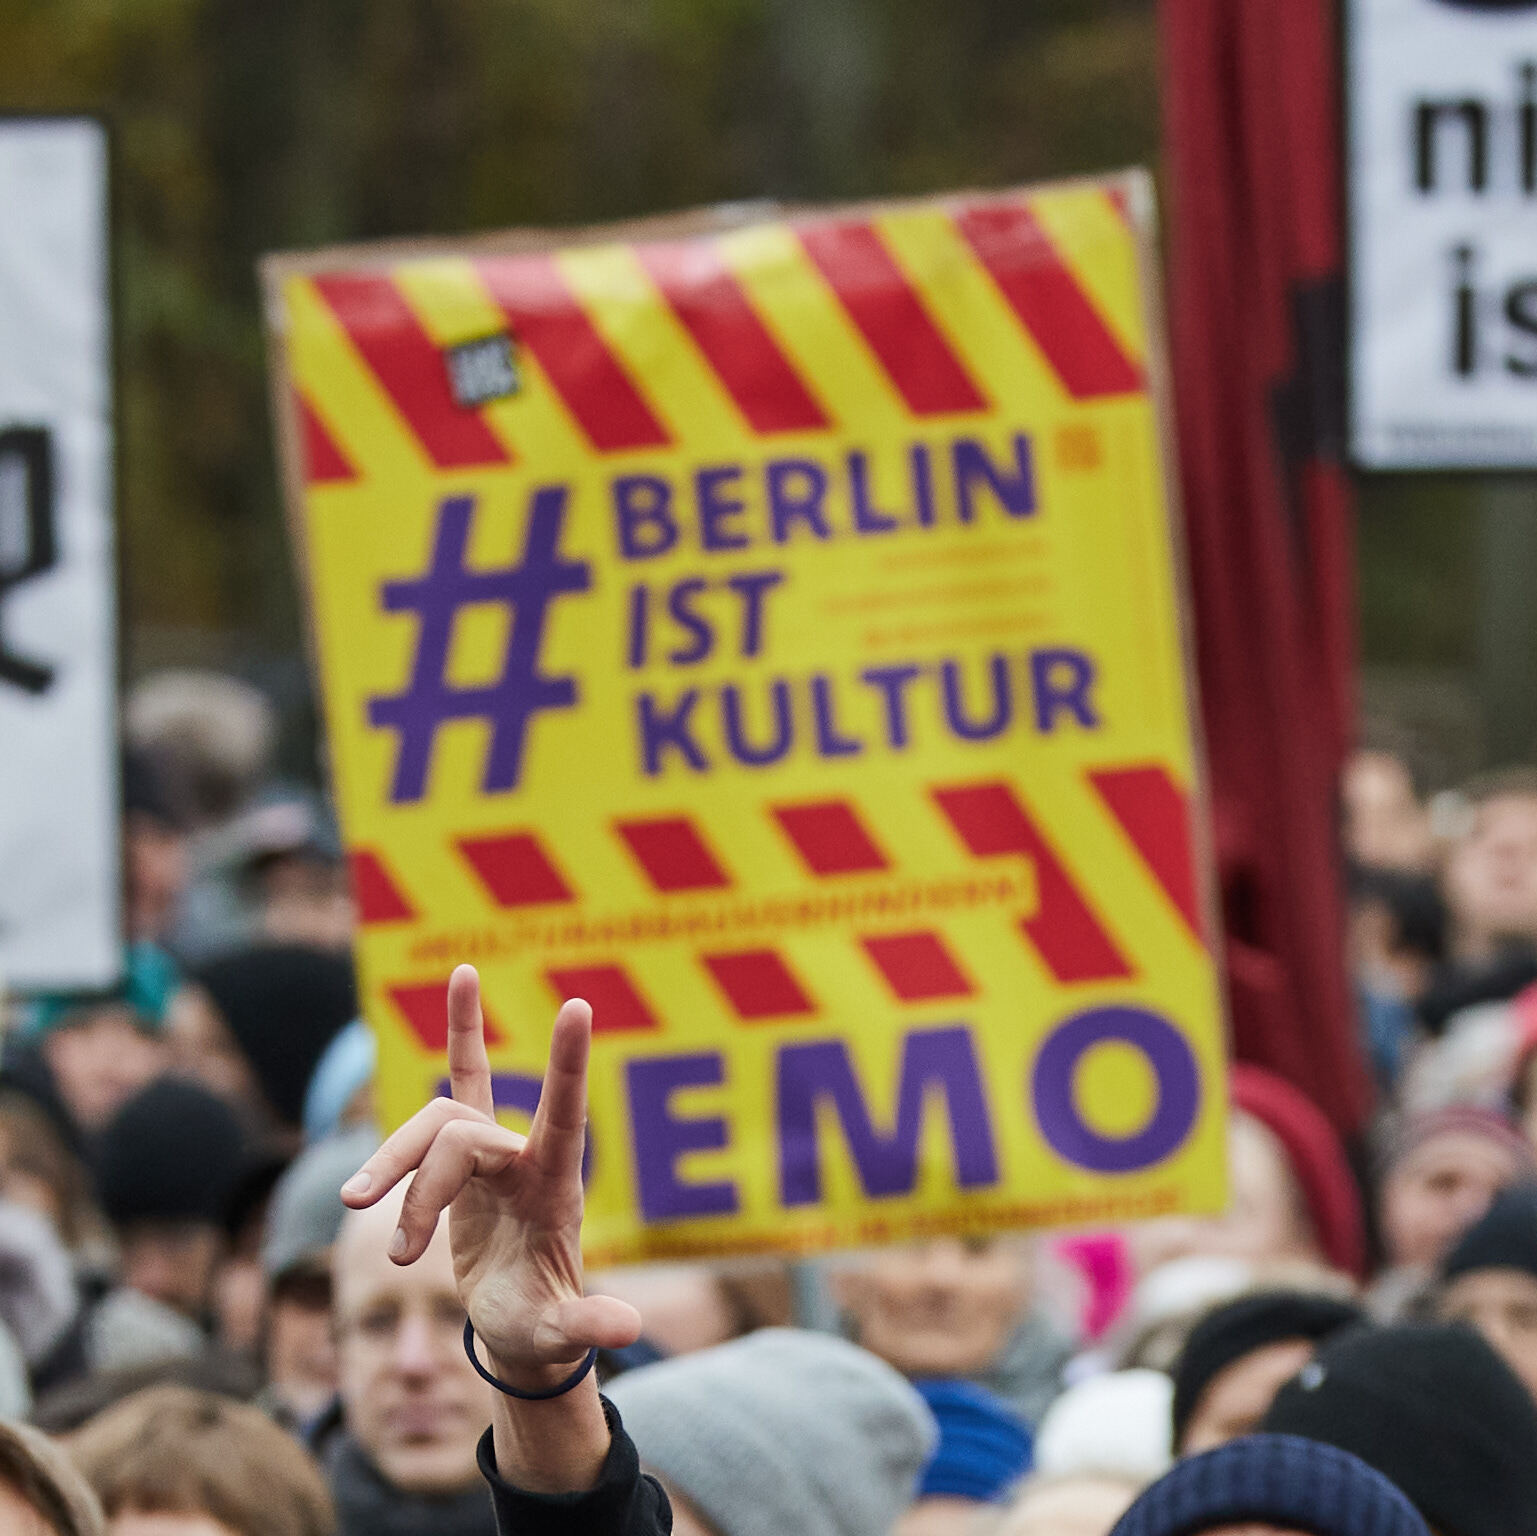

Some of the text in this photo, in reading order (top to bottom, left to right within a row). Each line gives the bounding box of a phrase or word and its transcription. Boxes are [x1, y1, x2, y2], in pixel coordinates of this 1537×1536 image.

[611, 432, 1041, 566] BERLIN
[626, 570, 788, 671] IST
[636, 646, 1104, 779] KULTUR
[436, 1004, 1202, 1224] EMO
